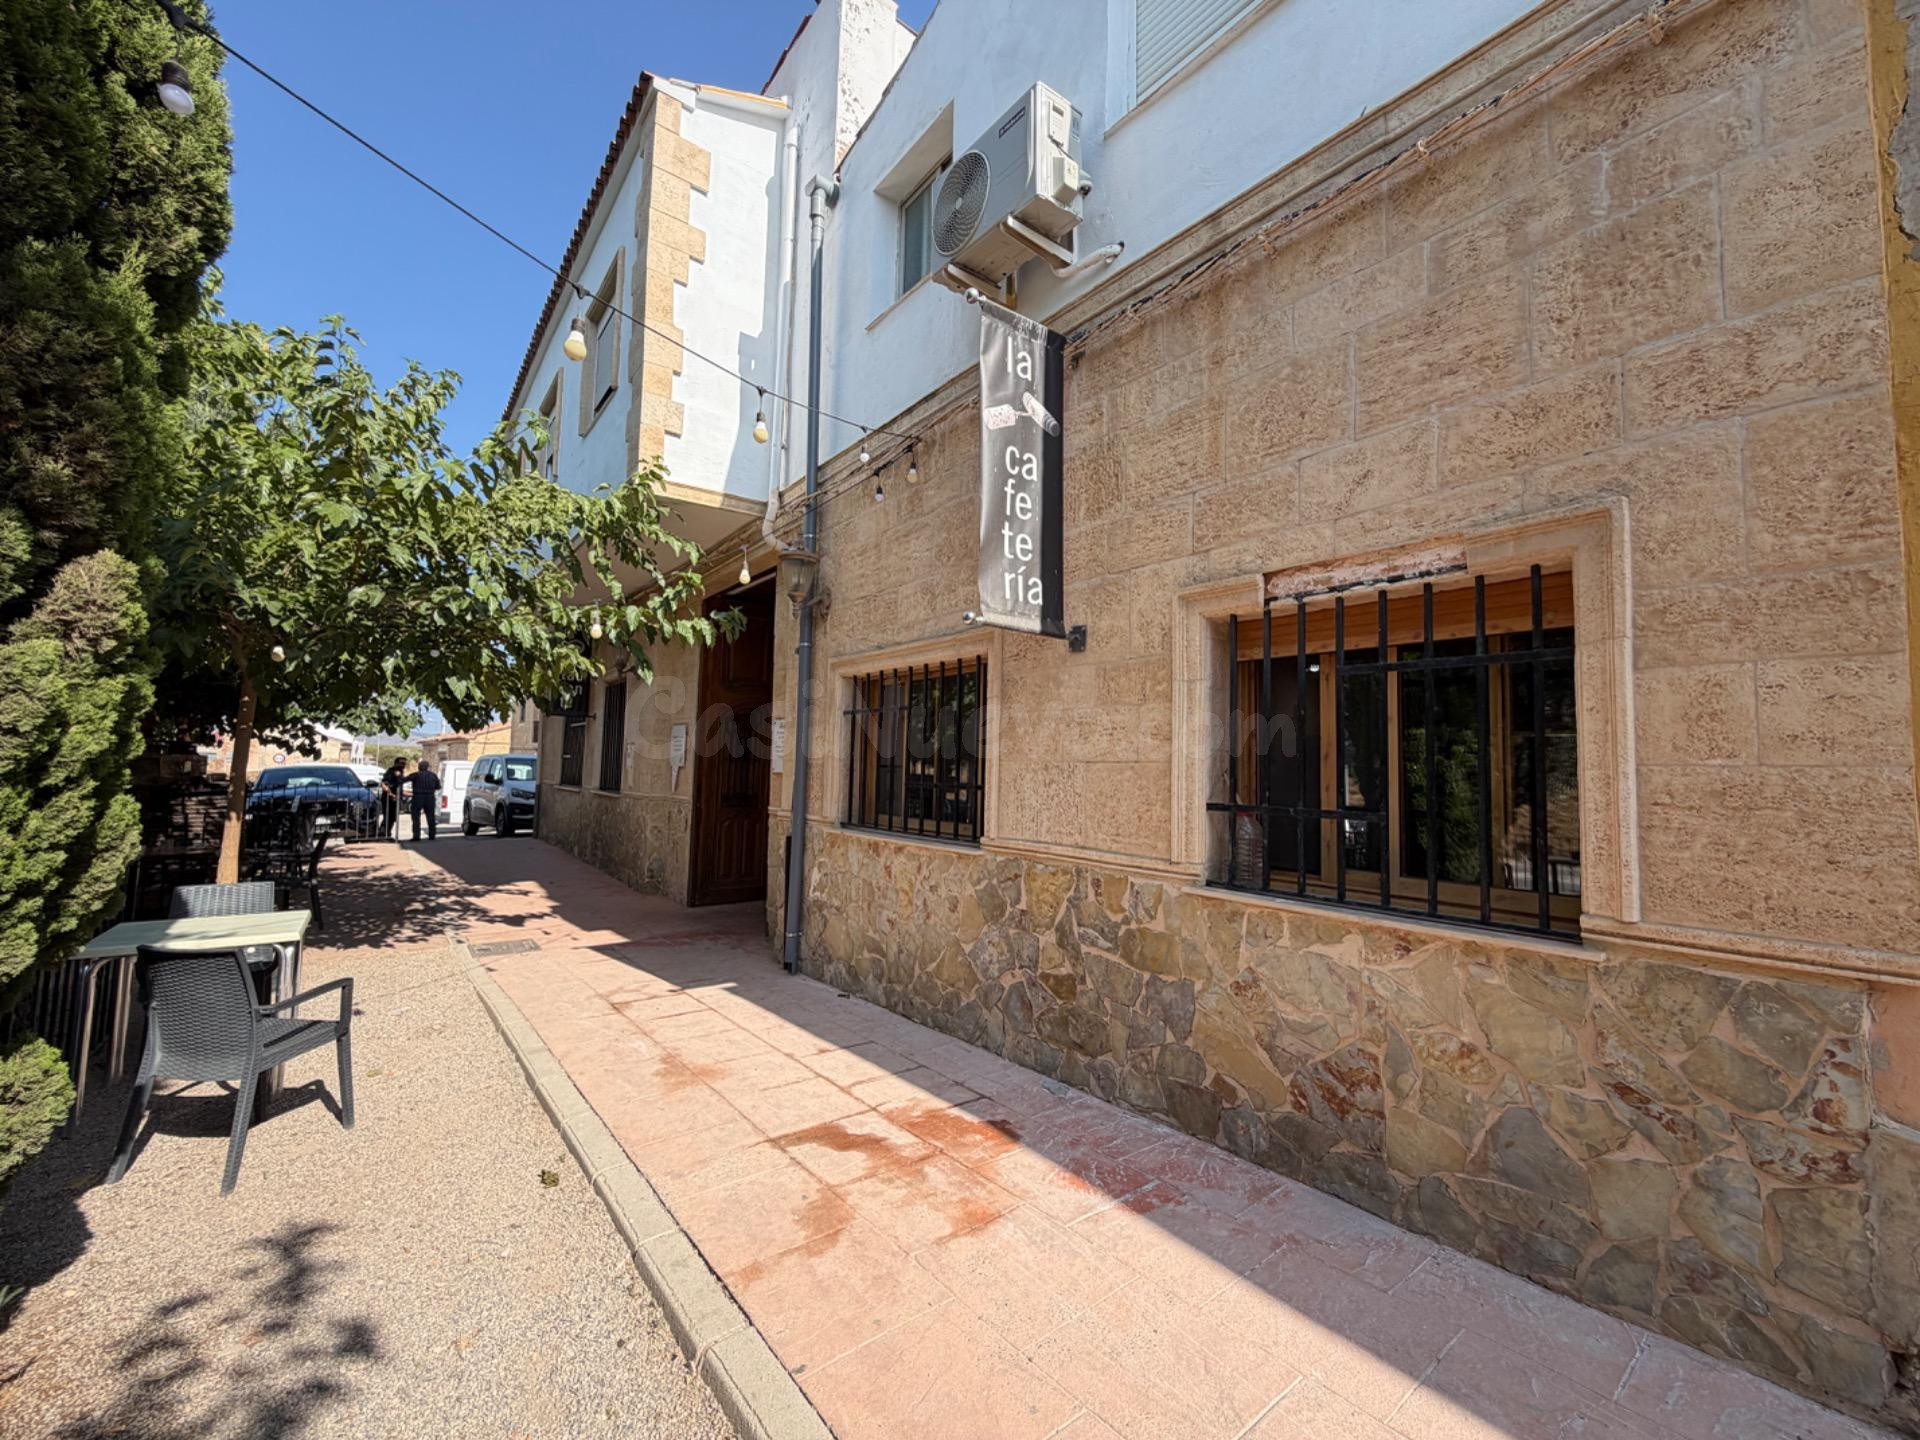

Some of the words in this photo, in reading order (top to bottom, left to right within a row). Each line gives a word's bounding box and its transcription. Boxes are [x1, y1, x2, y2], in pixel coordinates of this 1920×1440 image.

[1007, 337, 1032, 381] la
[1005, 445, 1038, 482] ca
[1004, 479, 1032, 520] fe
[1002, 522, 1033, 562] te
[1004, 567, 1044, 606] ría
